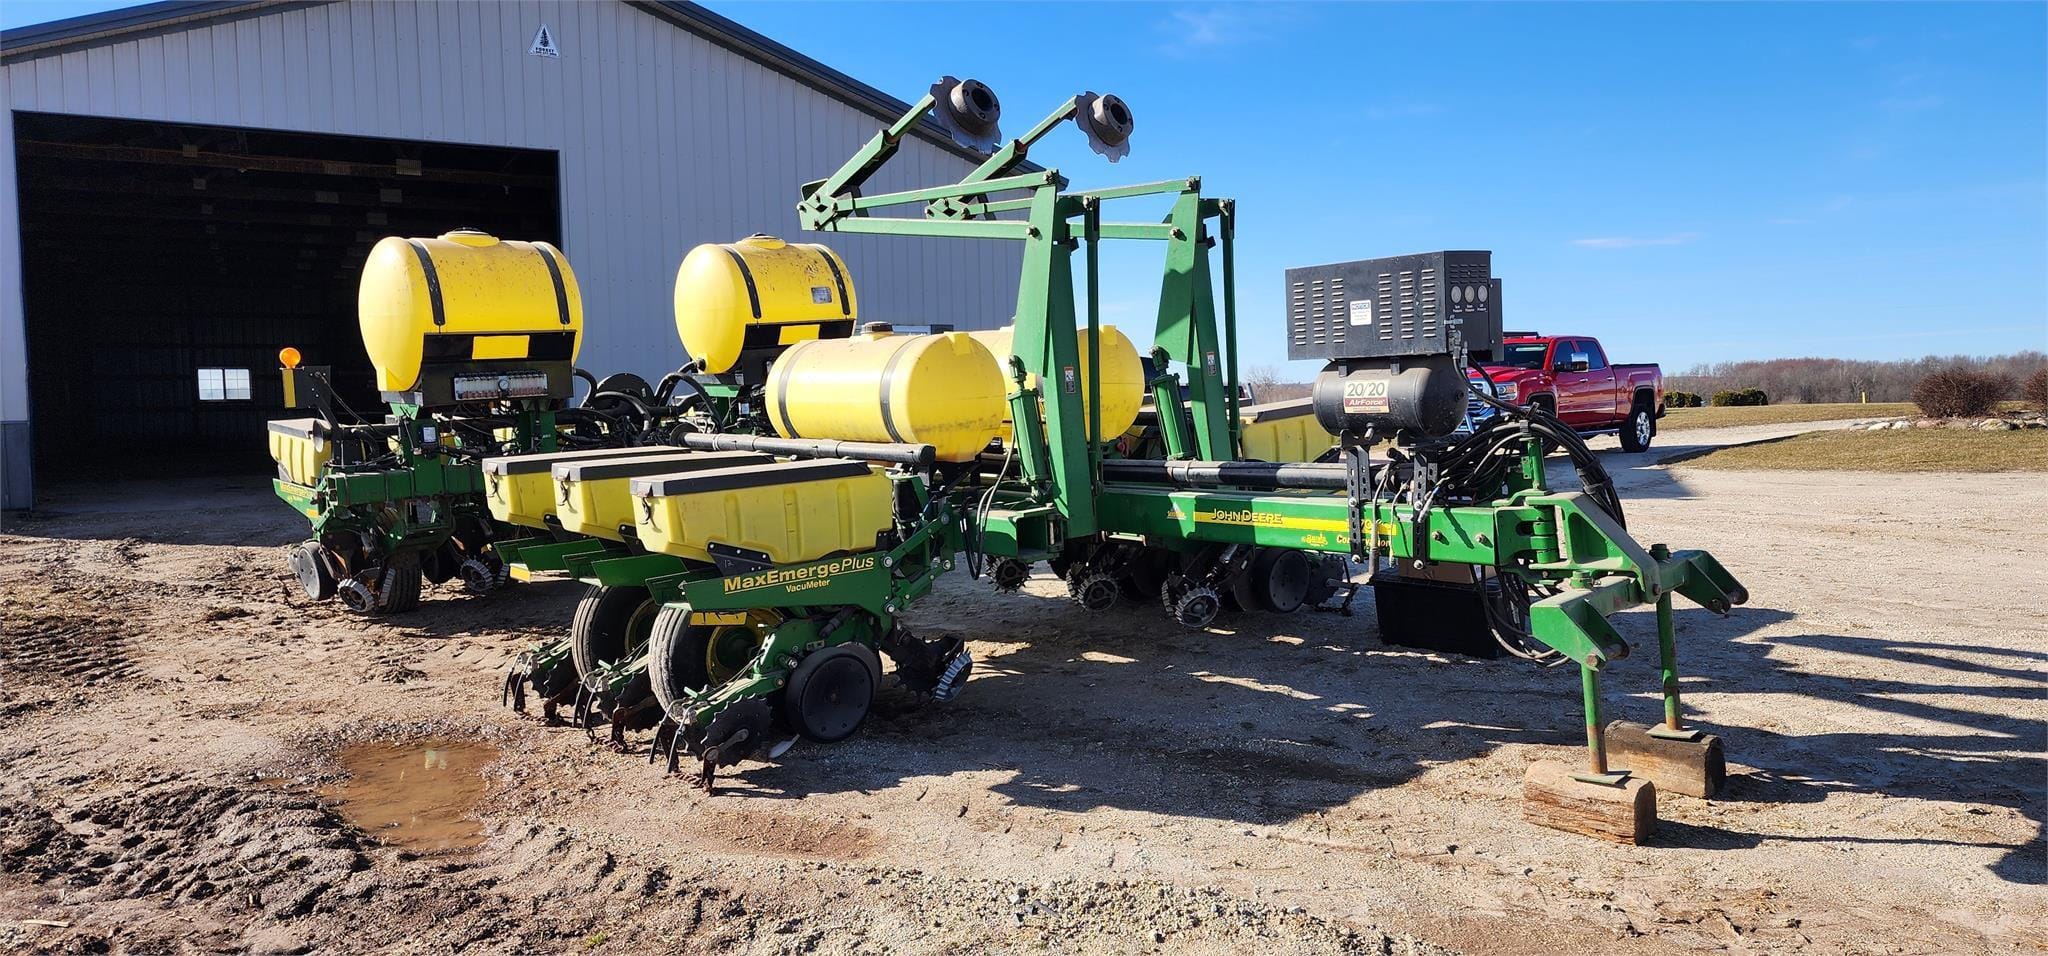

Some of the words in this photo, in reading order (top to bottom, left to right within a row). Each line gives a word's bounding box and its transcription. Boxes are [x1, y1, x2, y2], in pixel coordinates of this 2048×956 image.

[1347, 382, 1385, 397] 20/20
[1211, 507, 1241, 522] JOHN
[1241, 509, 1284, 525] DEERE
[785, 578, 831, 593] VacuMeter
